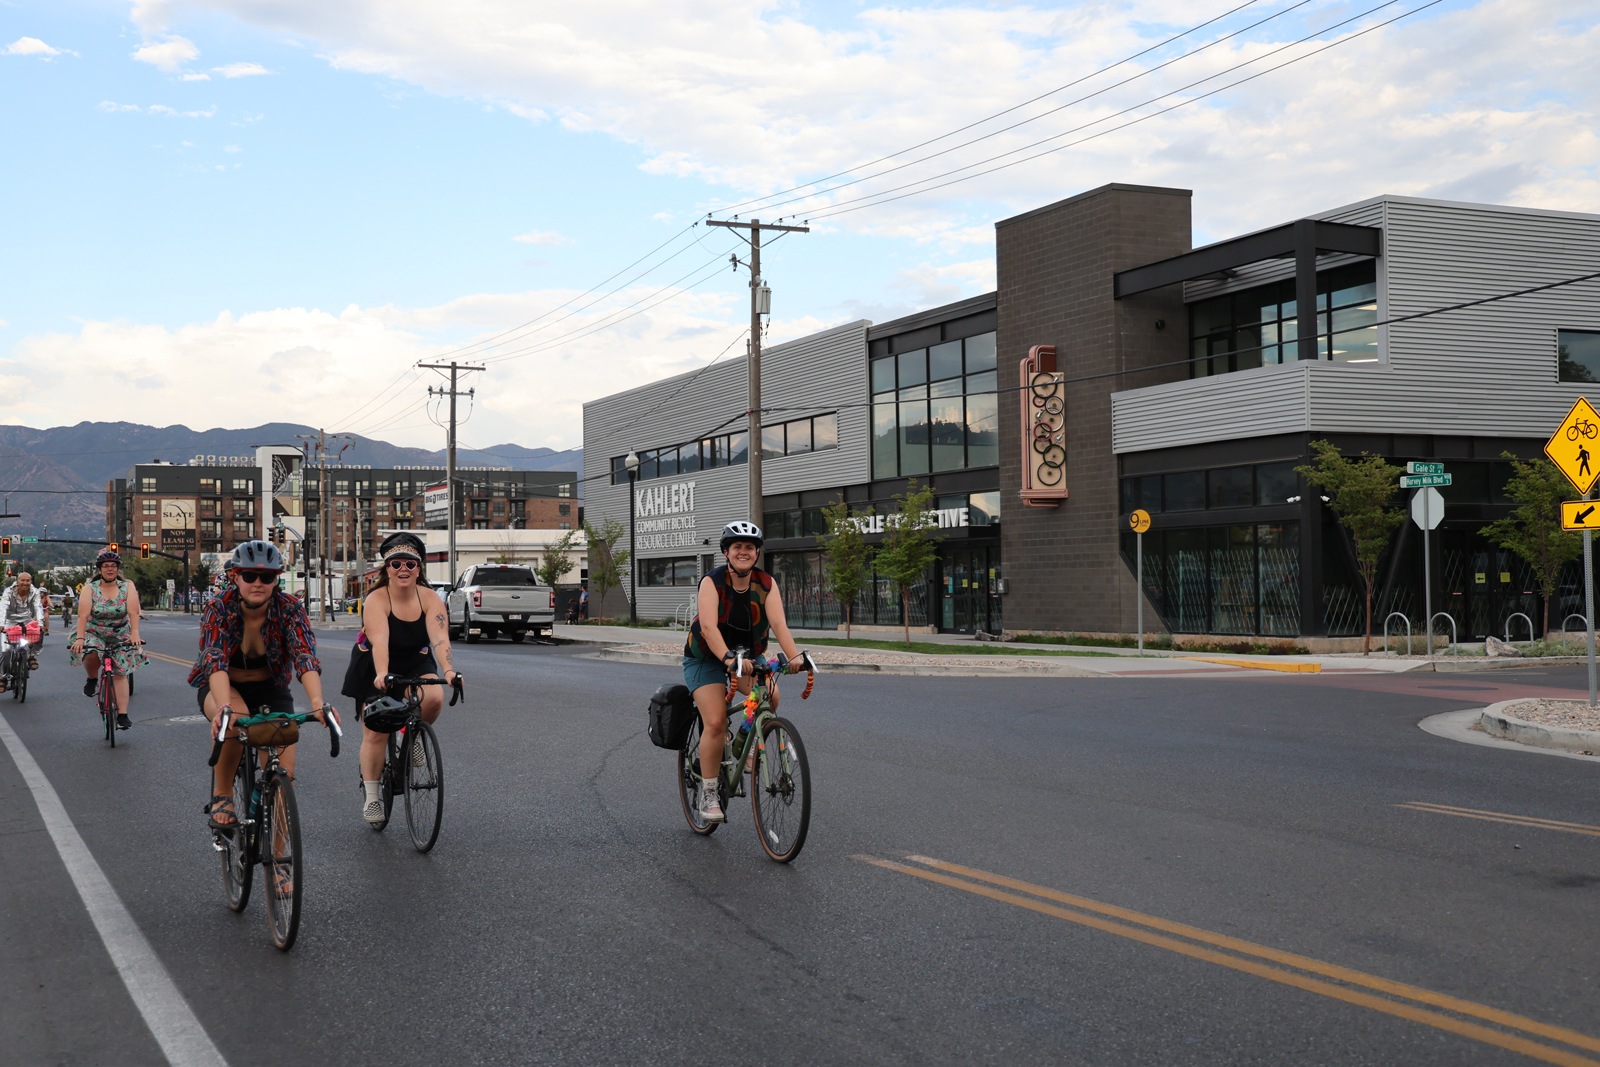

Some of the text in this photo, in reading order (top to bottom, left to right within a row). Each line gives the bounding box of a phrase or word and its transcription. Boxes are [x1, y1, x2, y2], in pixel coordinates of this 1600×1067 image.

[1416, 464, 1435, 472] Gale St
[1406, 478, 1421, 486] Harvey
[1433, 476, 1443, 484] Blvd
[437, 493, 448, 501] TIRES
[636, 482, 696, 517] KAHLERT
[636, 516, 696, 533] COMMUNITY BICYCLE
[886, 508, 968, 530] COECTIVE
[1130, 513, 1139, 528] 9
[636, 531, 696, 549] RESOURCE CENTER
